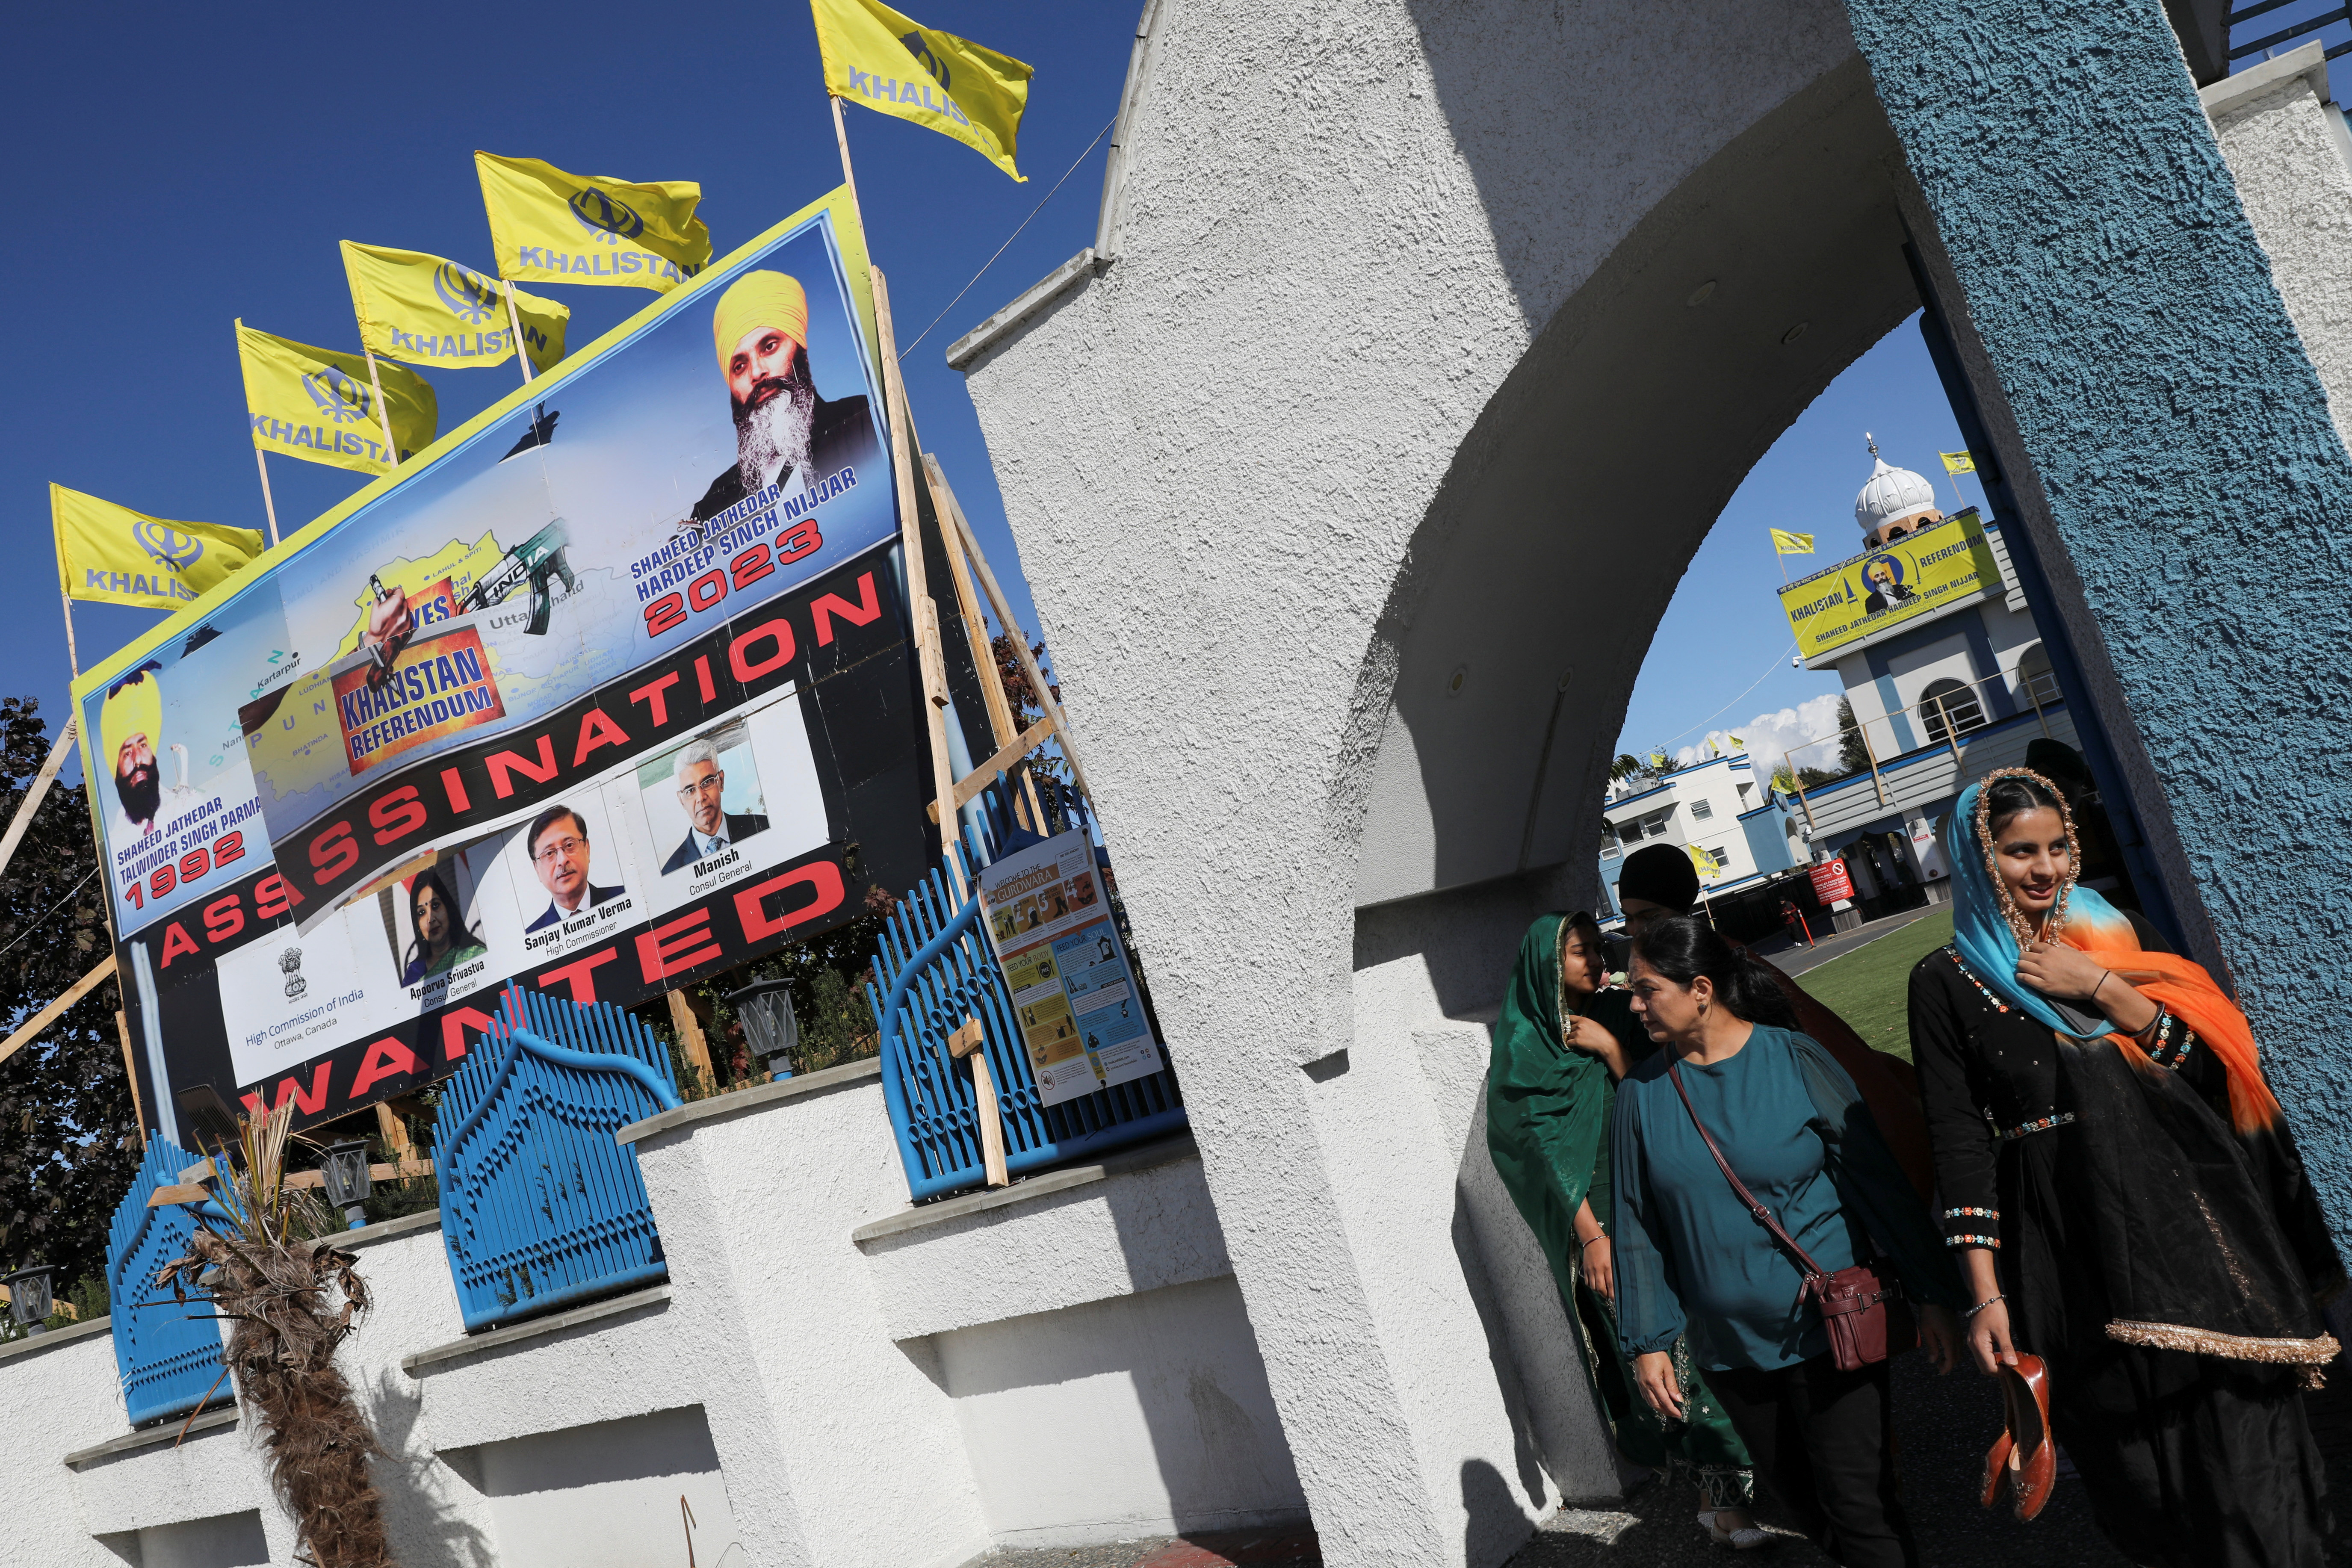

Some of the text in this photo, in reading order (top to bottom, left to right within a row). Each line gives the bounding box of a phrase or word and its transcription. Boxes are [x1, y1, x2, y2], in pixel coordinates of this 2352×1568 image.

[520, 246, 700, 283] KHALISTAN
[630, 482, 782, 580] SHAHEED JATHEDAR
[635, 466, 858, 603] HARDEEP SINGH NIJJAR
[433, 563, 457, 577] LAHUL
[464, 546, 482, 560] SPITI
[493, 546, 549, 597] INDIA
[644, 519, 823, 638] 2023
[1791, 534, 1984, 623] KHALISTAN REFERENDUM
[86, 569, 199, 602] KHALIS
[409, 596, 450, 629] YES
[1815, 571, 1980, 643] SHAHEED JATHEDAR HARDEEP SINGH NIJJAR
[1856, 623, 1873, 632] GURU
[1874, 613, 1897, 624] NANAK
[1899, 607, 1914, 615] SIKH
[1915, 591, 1953, 609] GURDWARA
[1953, 579, 1981, 592] SURREY
[257, 658, 301, 690] Kartarpur
[341, 647, 484, 732] KHALISTAN
[508, 688, 537, 702] BIJNOR
[350, 685, 494, 761] REFERENDUM
[293, 733, 328, 756] BHATINDA
[118, 797, 223, 866] SHAHEED JATHEDAR
[120, 841, 178, 886] TALWINDER
[181, 820, 218, 851] SINGH
[125, 830, 245, 910] 1992
[693, 848, 740, 878] Manish
[689, 860, 753, 896] Consul General
[995, 863, 1041, 889] WELCOME TO THE
[998, 870, 1053, 901] GURDWARA
[1824, 887, 1844, 895] RESPONSIBLE
[1826, 889, 1848, 898] INCONVENIENCE
[525, 898, 632, 951] Sanjay Kumar Verma
[546, 921, 618, 957] High Commissioner
[1056, 928, 1107, 953] FEED YOUR SOUL
[1007, 949, 1049, 973] FEED YOUR BODY
[239, 861, 844, 1125] WANTED
[410, 961, 485, 1001] Apoorva Srivastva
[424, 978, 478, 1008] Consul General
[245, 989, 364, 1047] High Commission of India
[274, 1017, 338, 1050] Ottawa, Canada
